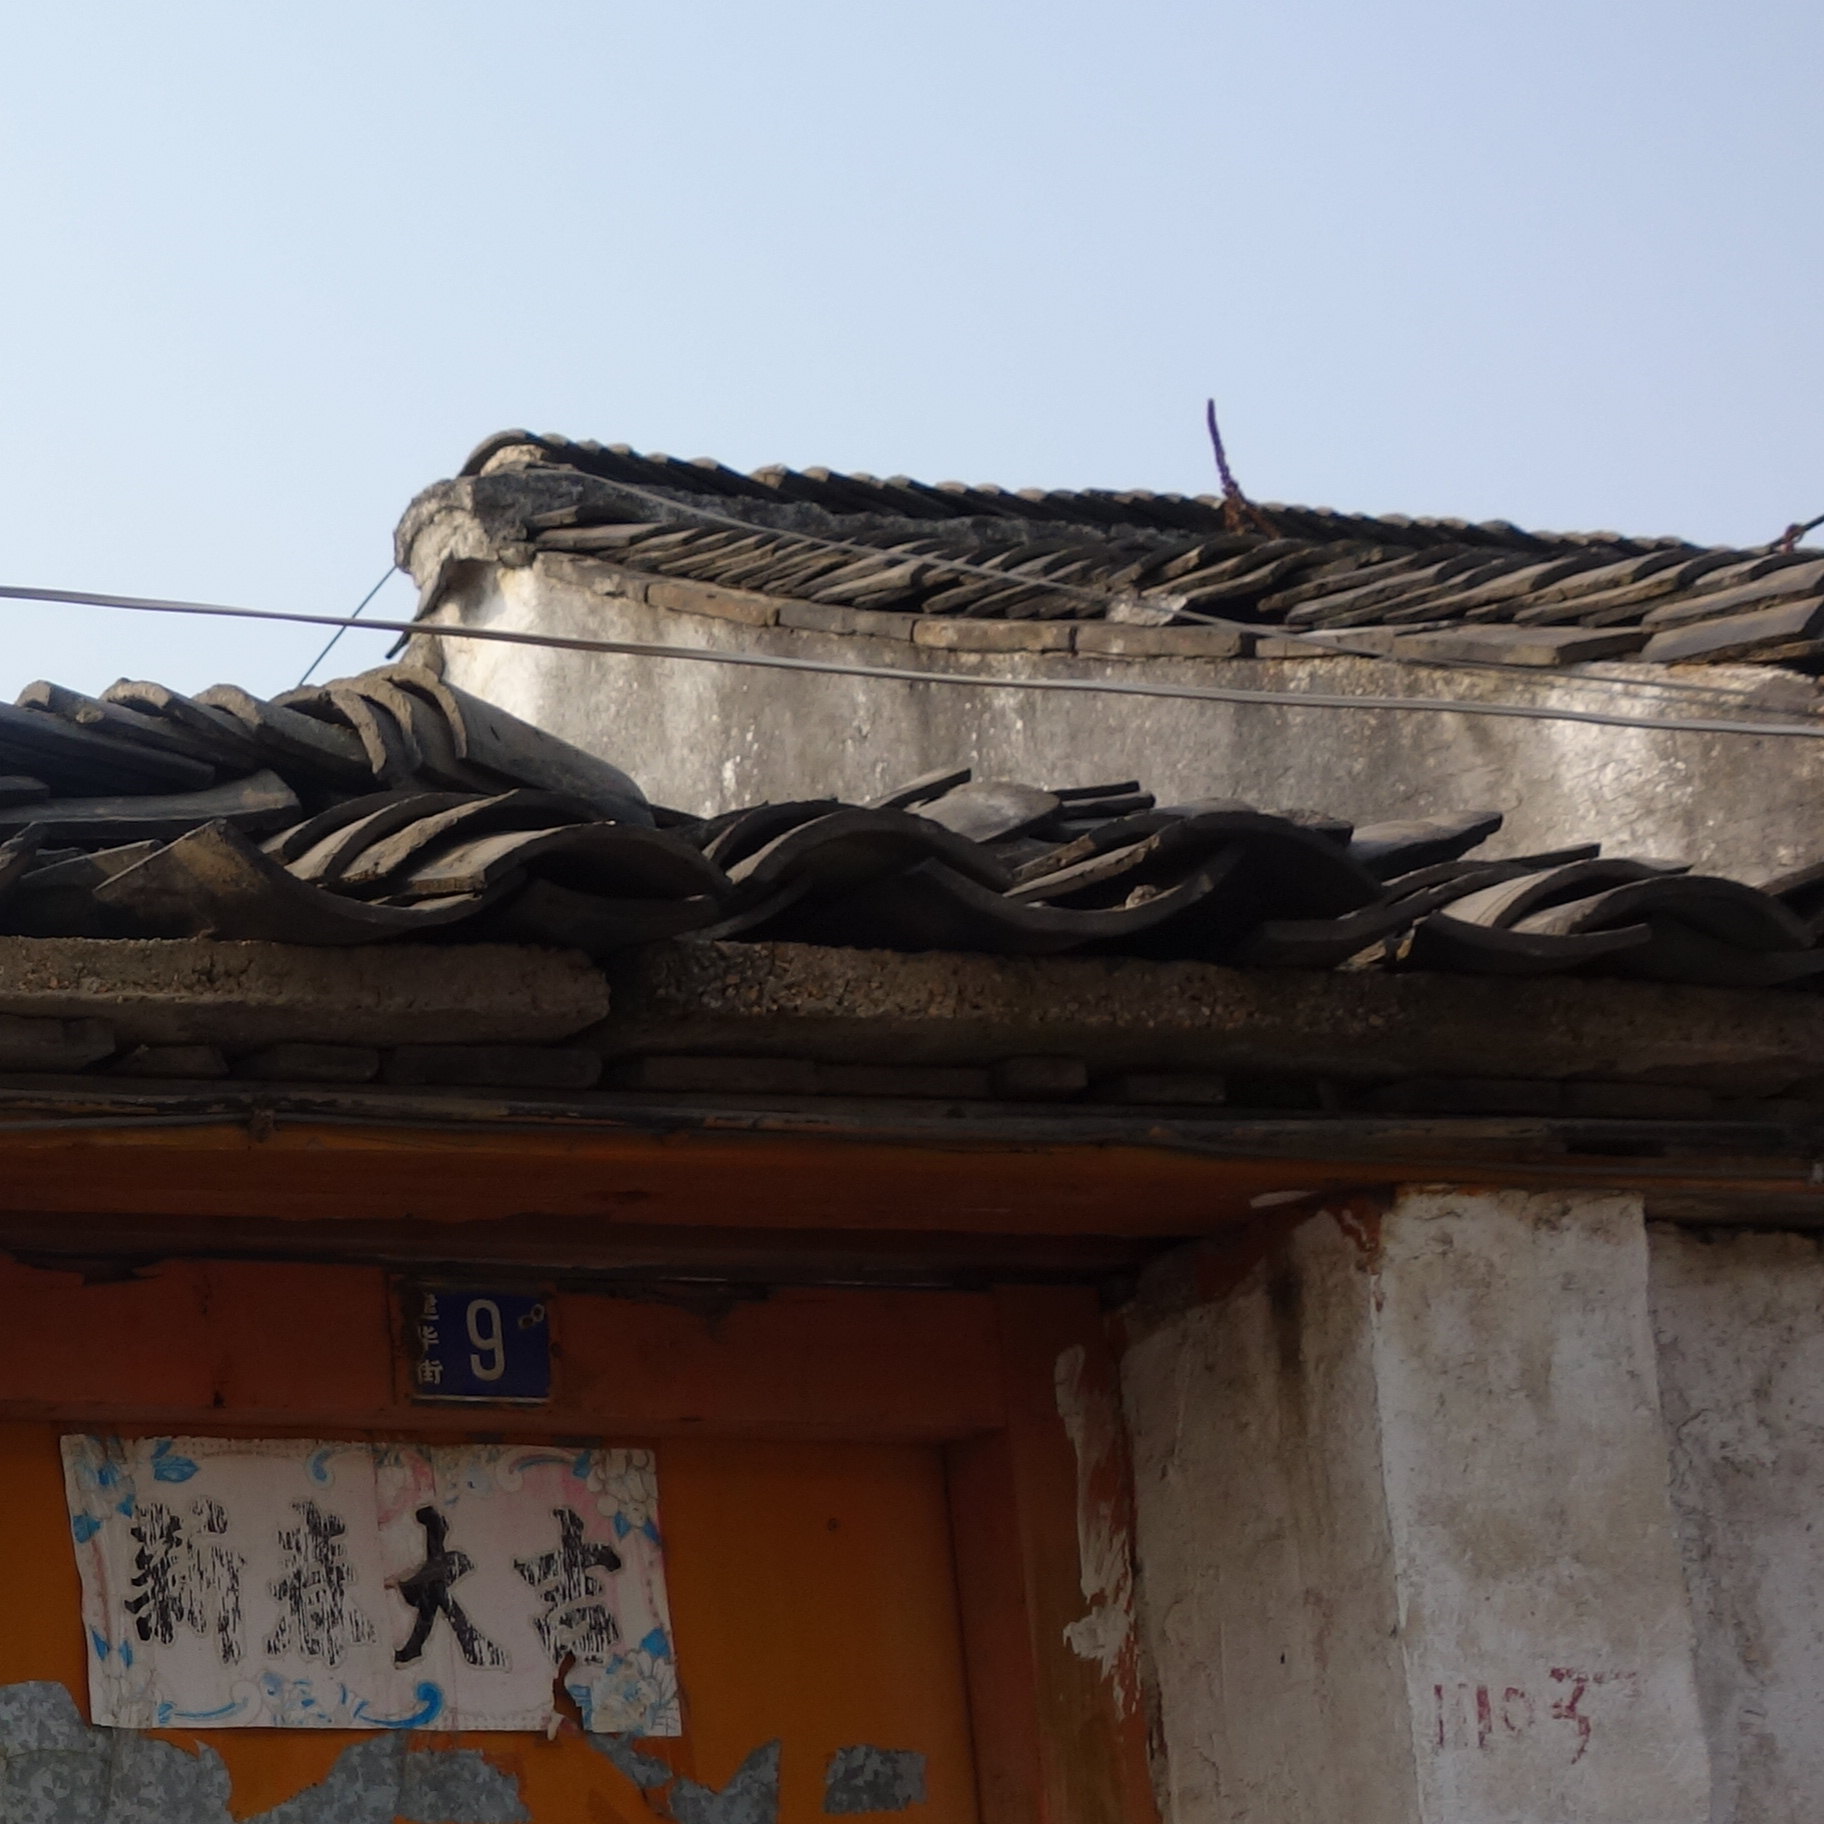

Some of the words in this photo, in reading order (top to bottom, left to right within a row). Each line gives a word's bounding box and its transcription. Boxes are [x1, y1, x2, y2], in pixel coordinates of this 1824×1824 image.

[465, 1298, 507, 1382] 9
[124, 1497, 623, 1670] 新春大吉
